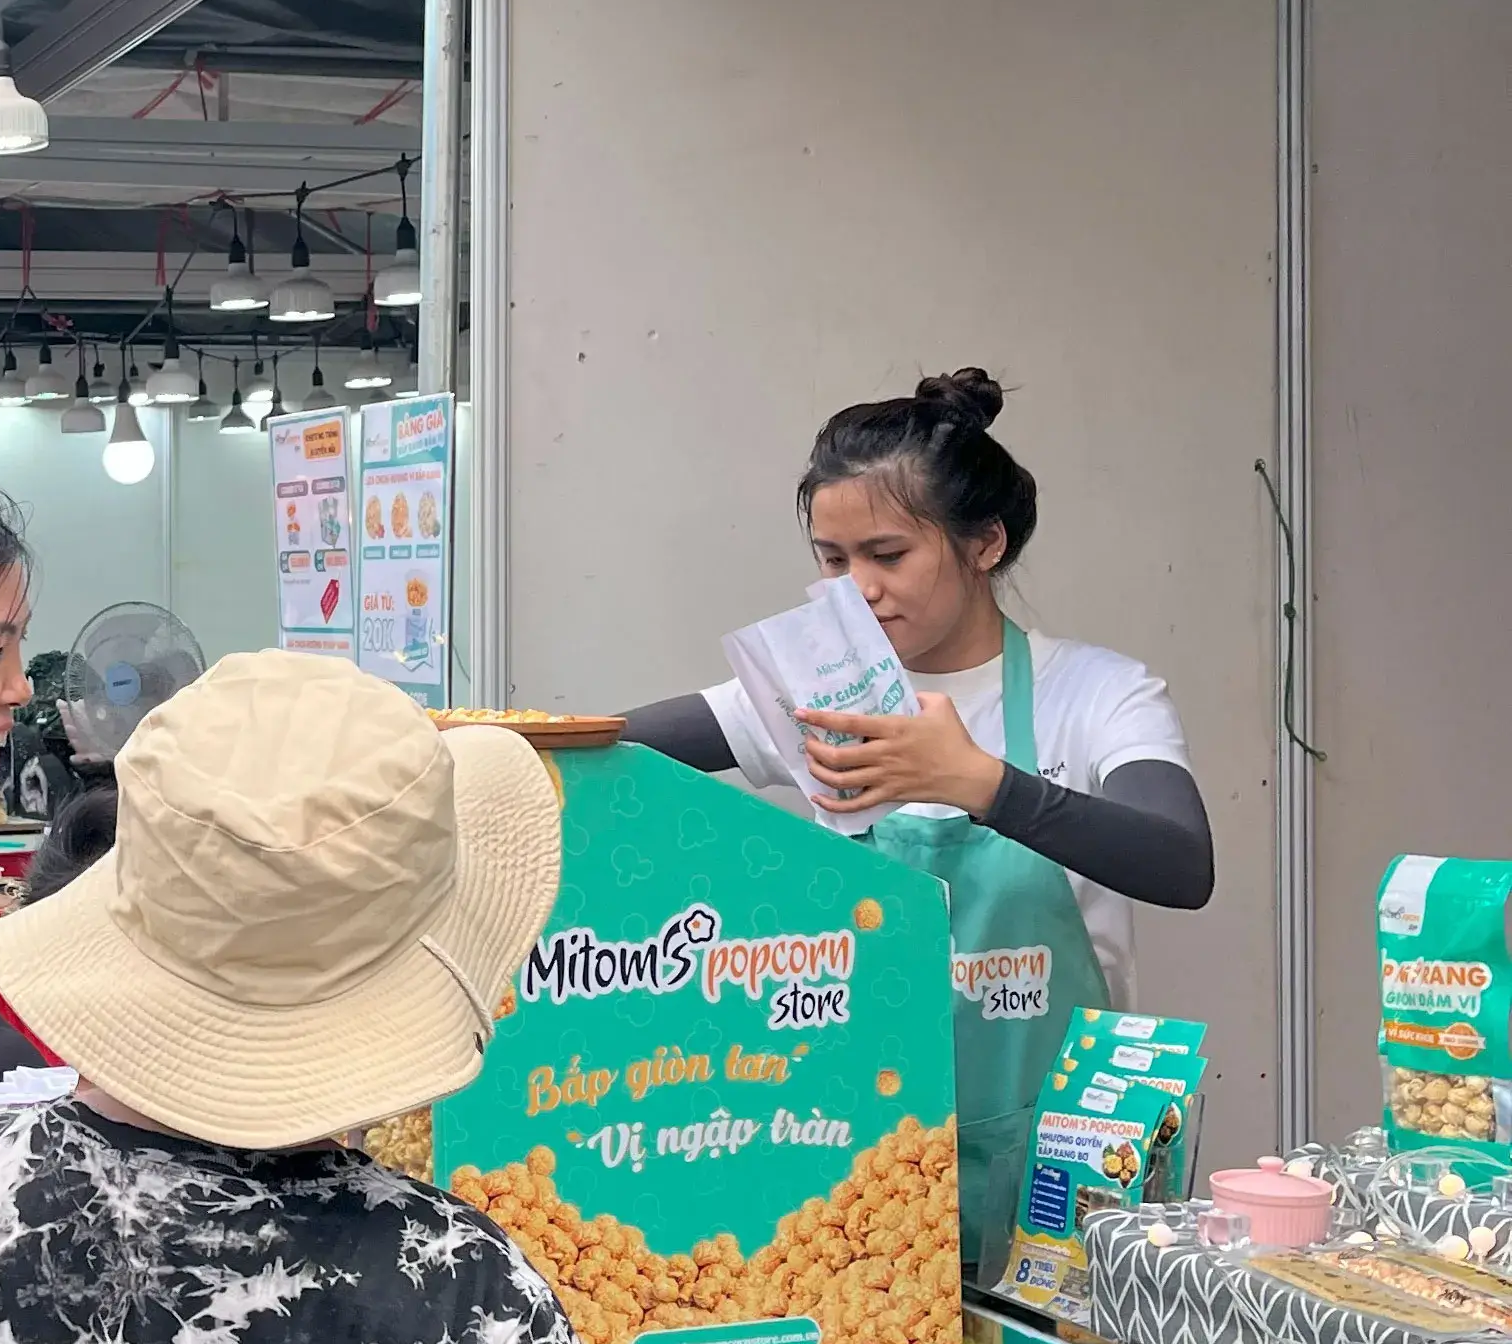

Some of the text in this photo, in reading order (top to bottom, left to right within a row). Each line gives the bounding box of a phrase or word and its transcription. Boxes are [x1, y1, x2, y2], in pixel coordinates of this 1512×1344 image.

[706, 936, 849, 997] popcorn
[951, 952, 1044, 994] opcorn
[773, 983, 844, 1024] store
[990, 983, 1041, 1013] store
[525, 1054, 618, 1117] Bắp
[626, 1045, 715, 1101] giòn
[588, 1107, 853, 1173] Vị ngập tràn
[1089, 1120, 1143, 1137] POPCORN
[1015, 1258, 1031, 1283] 8
